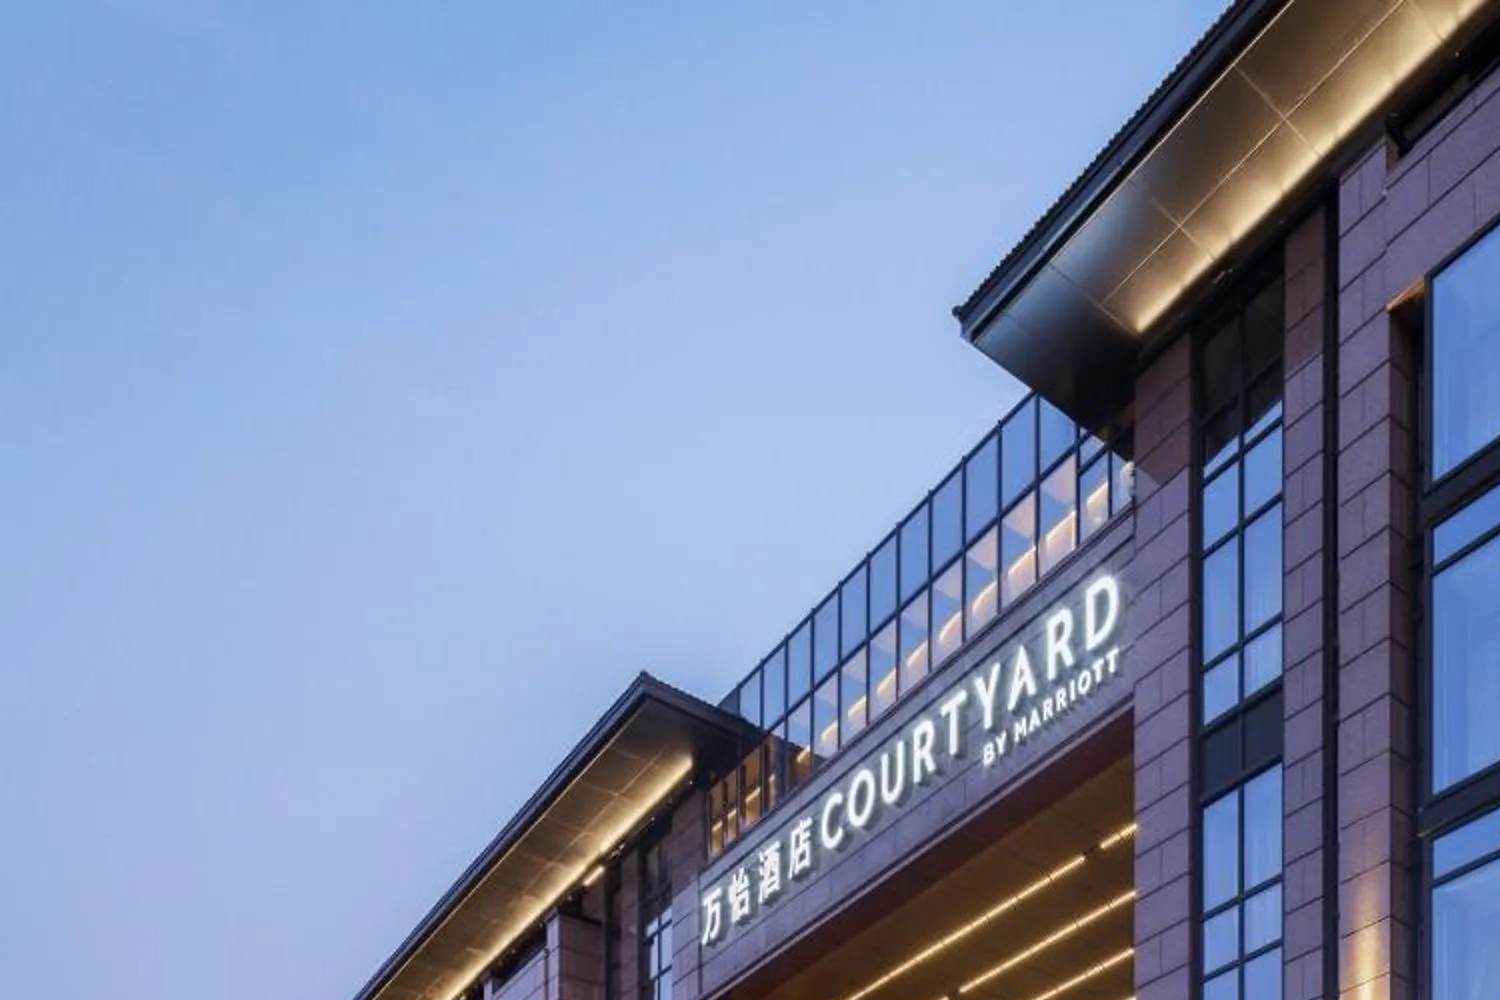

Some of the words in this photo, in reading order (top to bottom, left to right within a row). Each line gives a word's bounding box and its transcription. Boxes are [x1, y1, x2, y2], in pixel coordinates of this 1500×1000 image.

[820, 573, 1119, 851] COURTYARD
[983, 730, 1007, 767] BY
[1013, 647, 1119, 743] MARRIOTT
[701, 815, 813, 946] 万怡酒店
